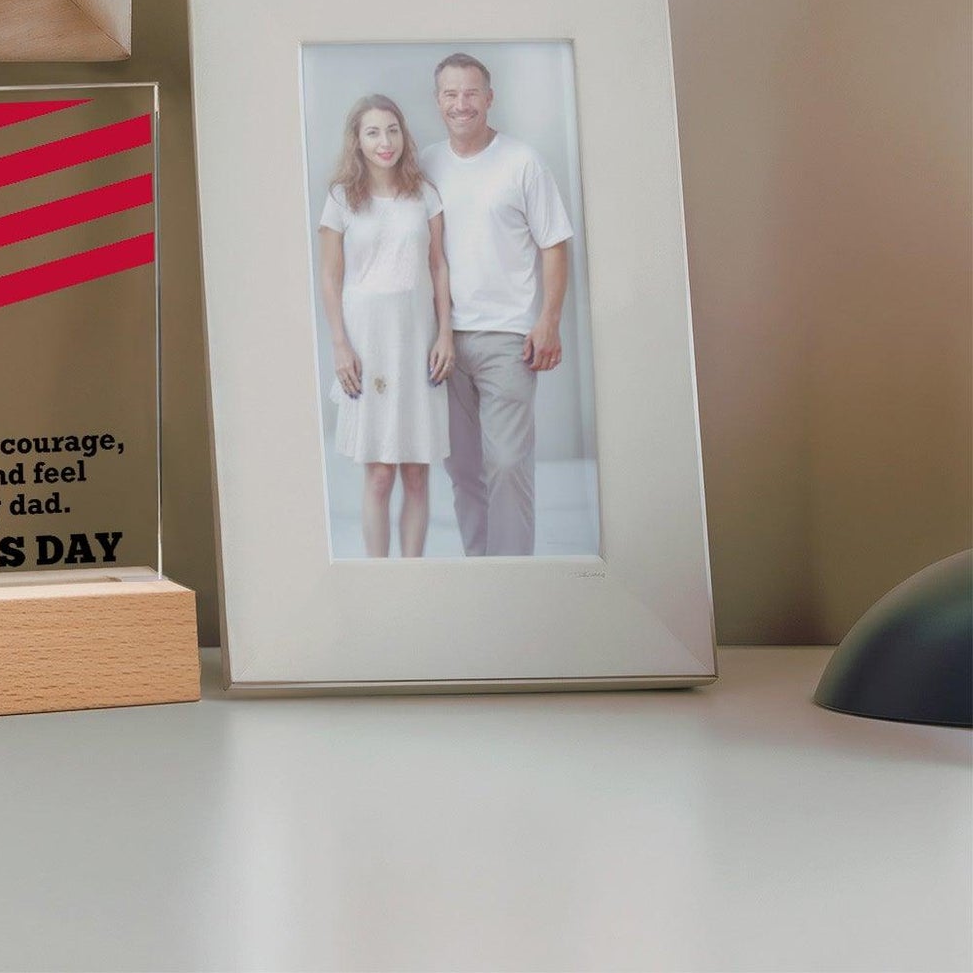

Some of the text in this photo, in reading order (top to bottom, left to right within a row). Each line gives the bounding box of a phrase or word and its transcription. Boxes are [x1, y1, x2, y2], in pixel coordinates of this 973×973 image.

[0, 433, 125, 458] courage,
[33, 459, 87, 485] feel
[9, 491, 71, 516] dad.
[35, 531, 124, 566] DAY
